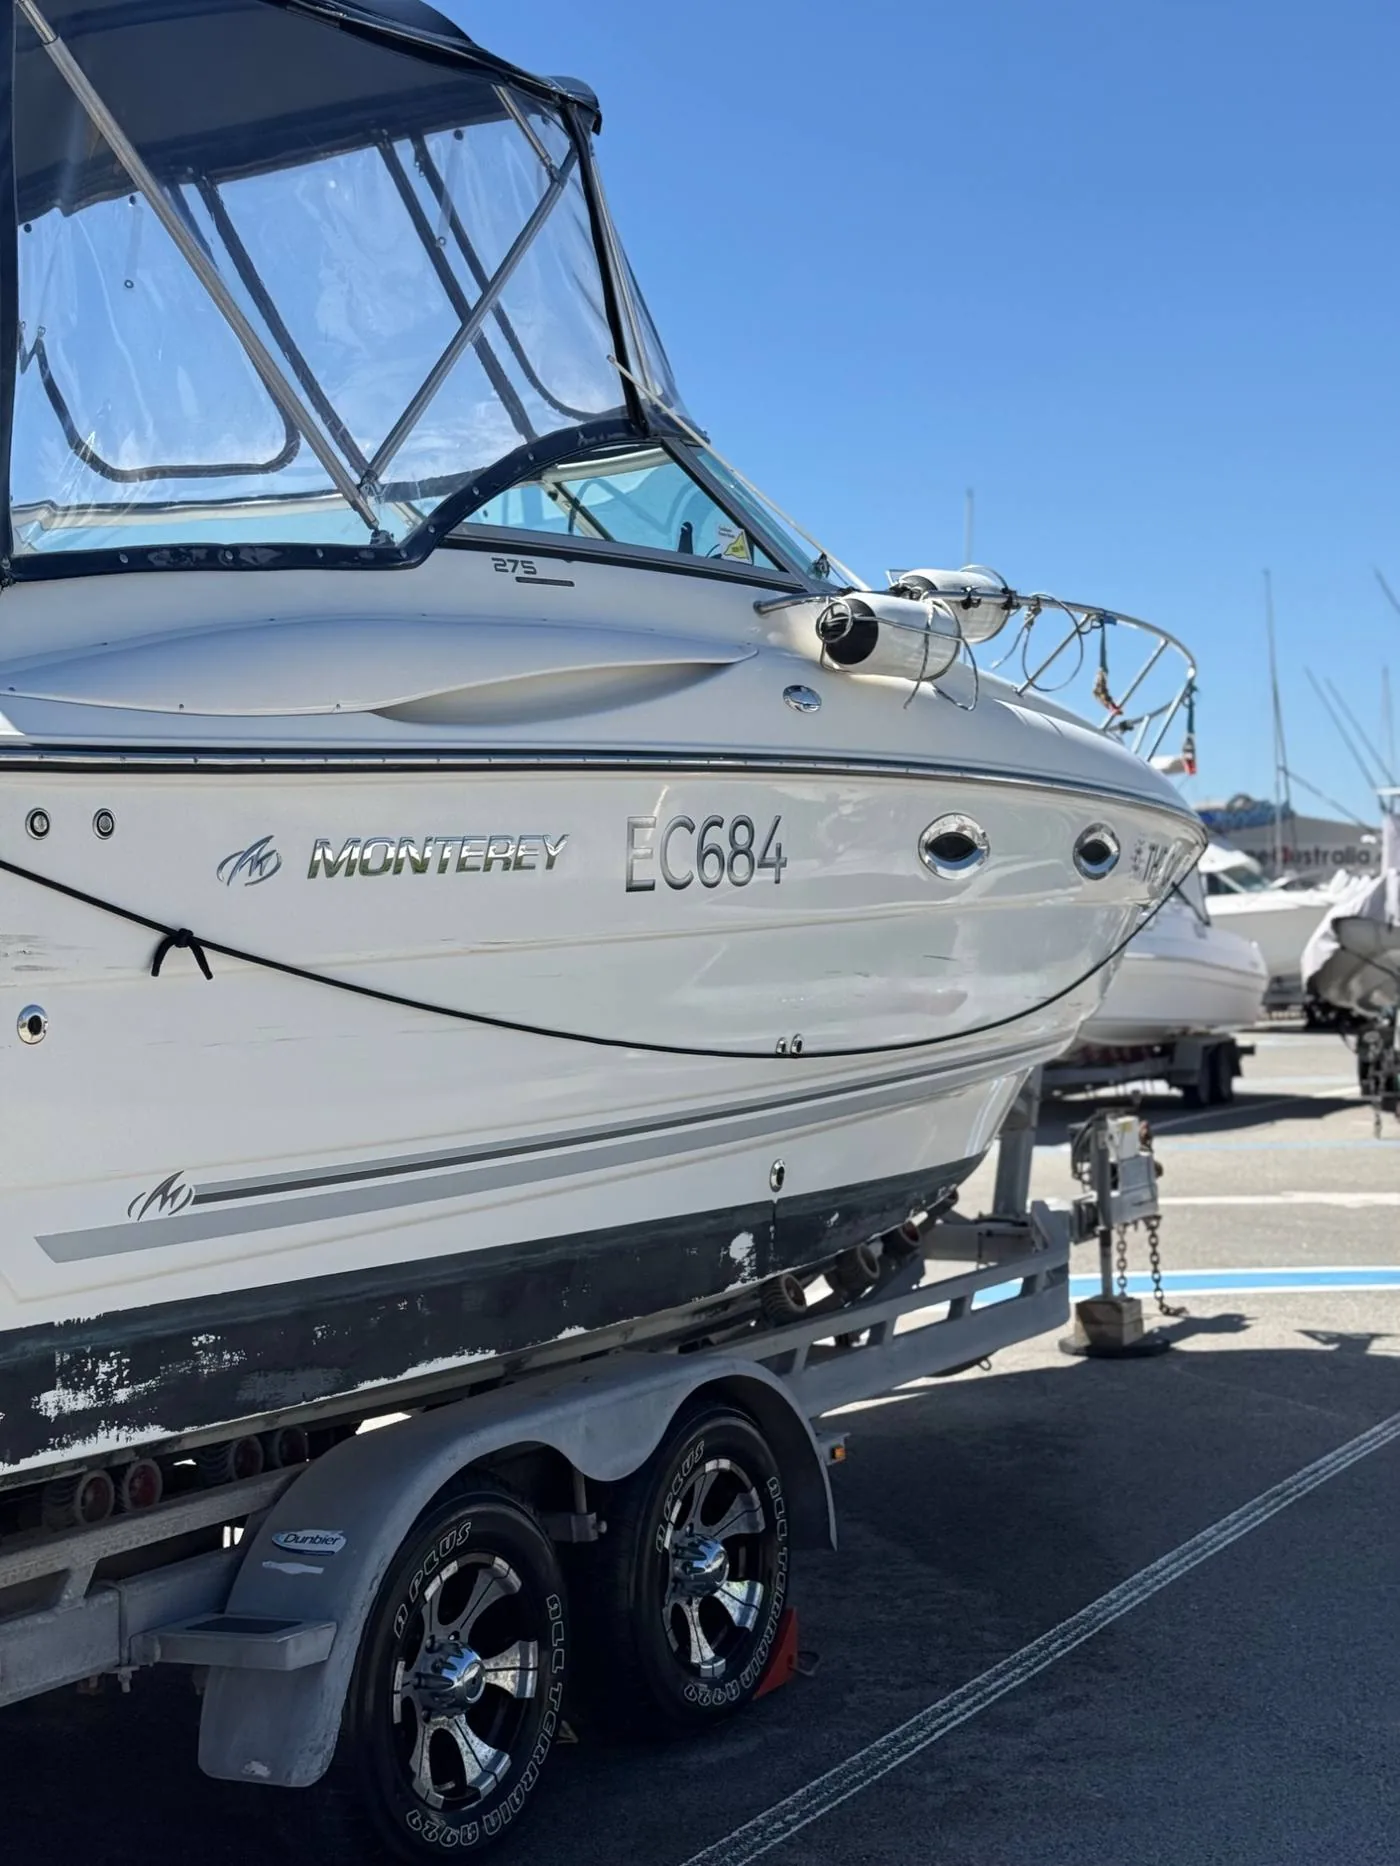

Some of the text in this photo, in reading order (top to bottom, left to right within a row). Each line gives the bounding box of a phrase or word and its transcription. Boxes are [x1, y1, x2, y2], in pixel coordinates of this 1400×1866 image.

[491, 557, 537, 575] 275
[307, 833, 571, 879] MONTEREY
[625, 814, 788, 892] EC684
[283, 1533, 341, 1546] Dunbier
[766, 1476, 788, 1542] ALL
[739, 1547, 789, 1689] TERRAIN
[406, 1593, 565, 1848] ALL TERRAIN A929
